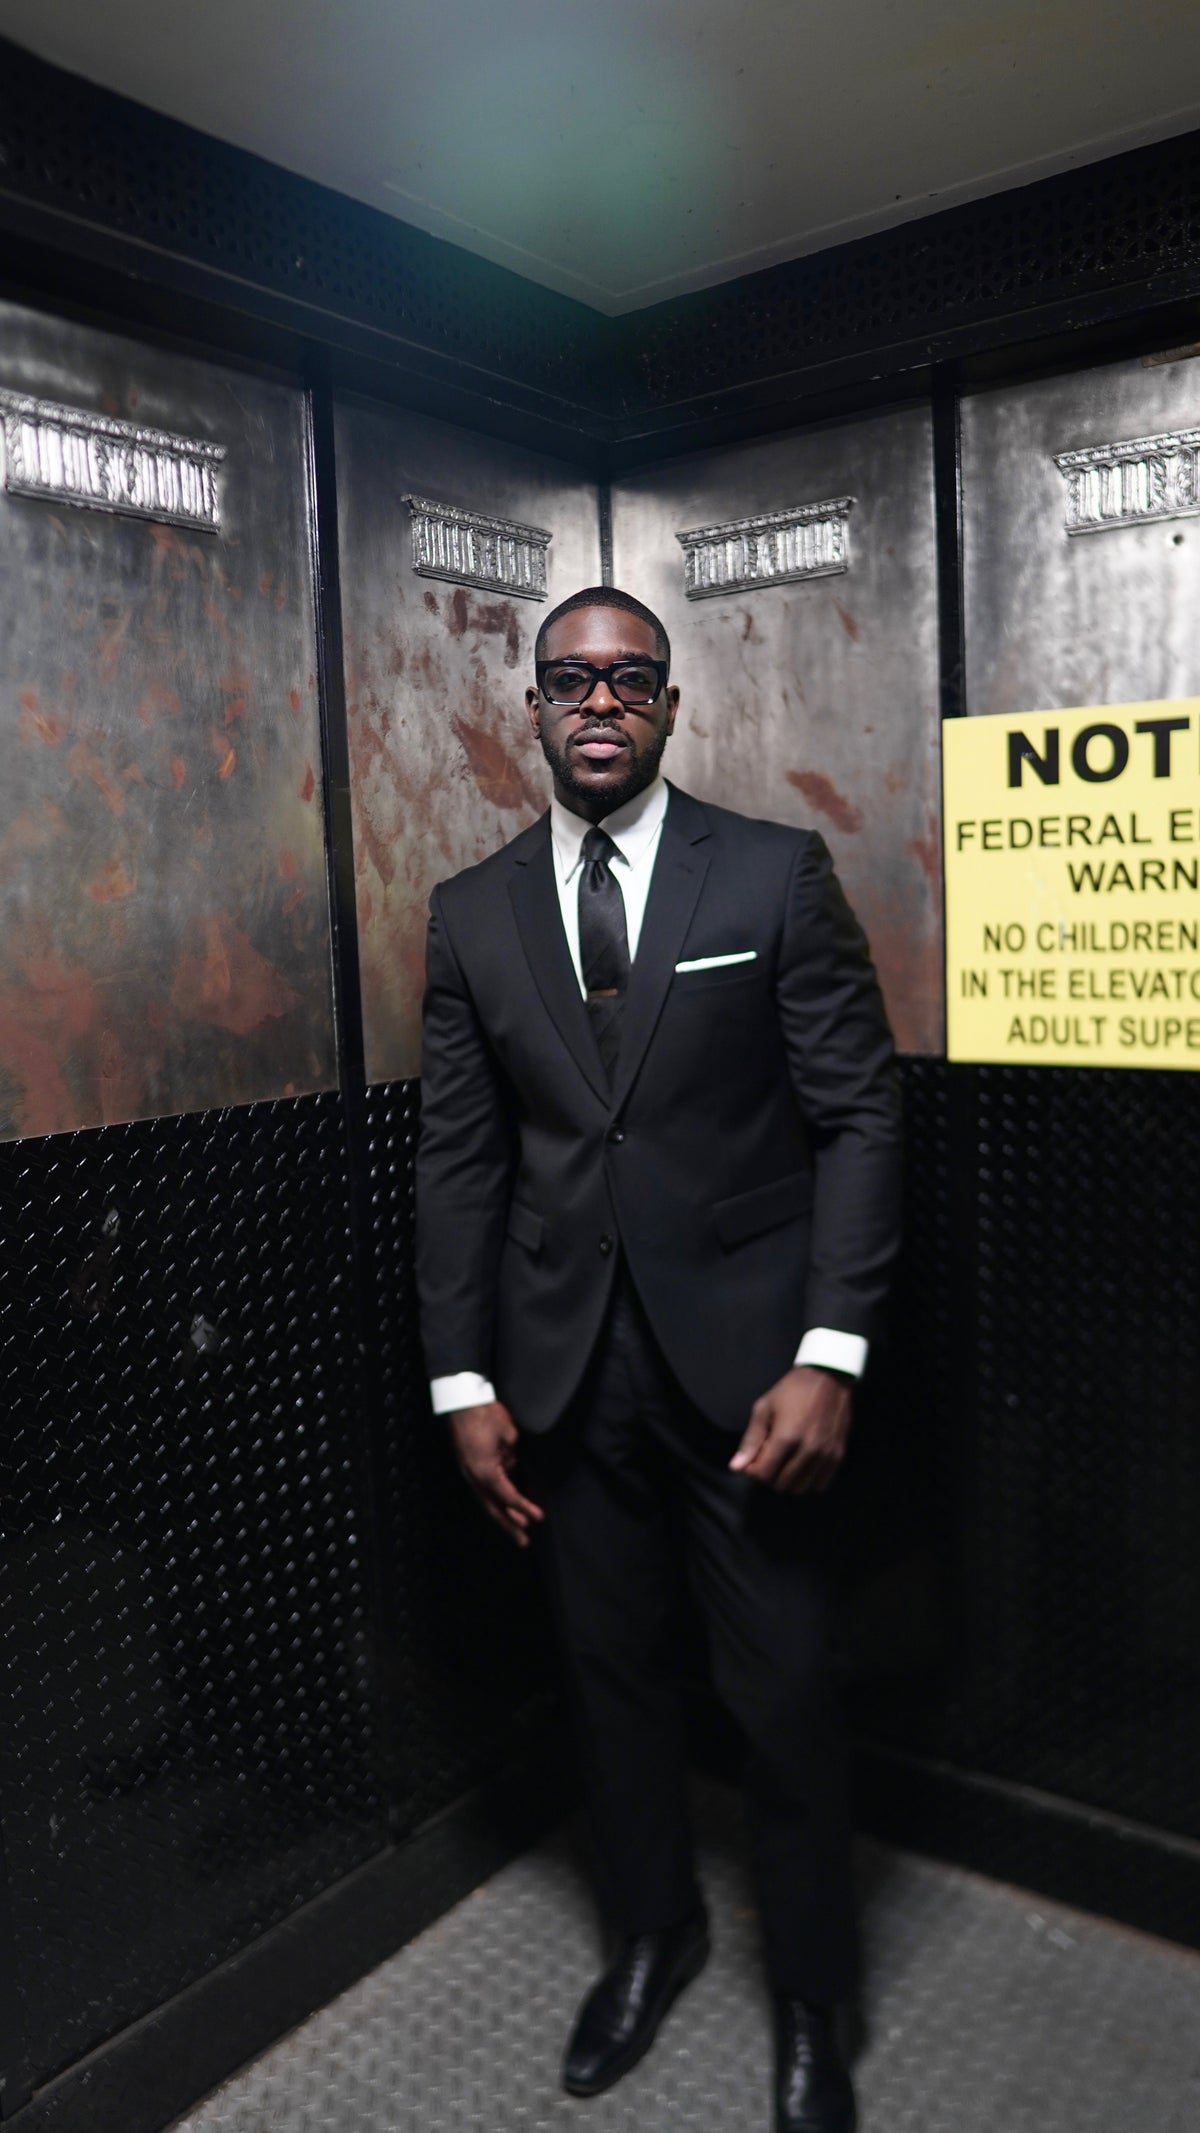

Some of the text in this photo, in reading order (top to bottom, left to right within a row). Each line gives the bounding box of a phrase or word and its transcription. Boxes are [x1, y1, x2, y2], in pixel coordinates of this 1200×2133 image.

[1007, 715, 1200, 789] NOT
[956, 808, 1200, 852] FEDERAL E
[1067, 858, 1199, 894] WARN
[984, 921, 1199, 953] NO CHILDREN
[961, 971, 988, 998] IN
[1000, 969, 1055, 999] THE
[1008, 1016, 1200, 1049] ADULT SUPE
